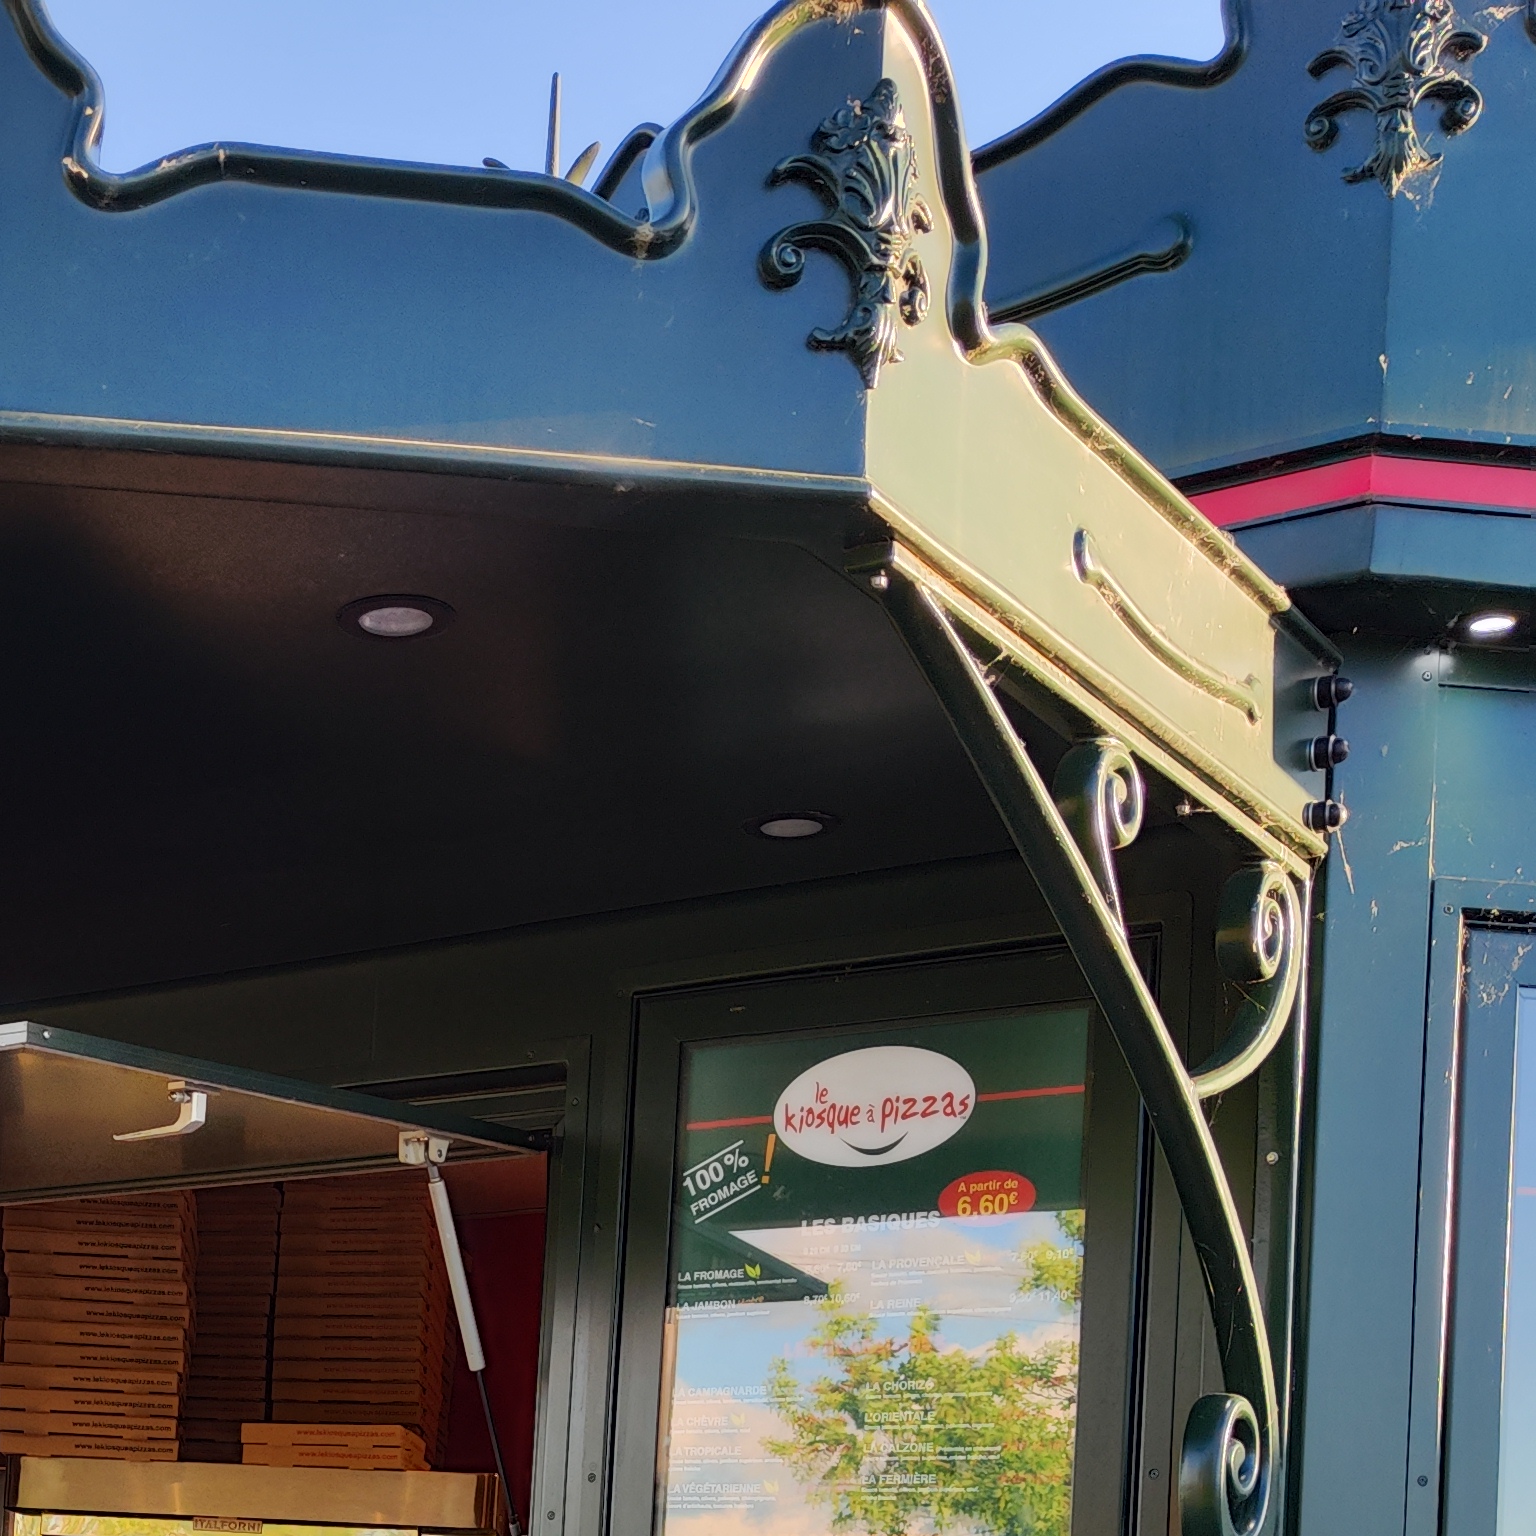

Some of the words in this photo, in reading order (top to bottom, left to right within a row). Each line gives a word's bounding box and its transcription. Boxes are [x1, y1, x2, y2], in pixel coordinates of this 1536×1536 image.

[815, 1081, 828, 1105] le
[784, 1102, 860, 1134] kiosque
[866, 1104, 875, 1123] à
[881, 1091, 970, 1133] pizzas
[690, 1170, 758, 1216] FROMAGE
[958, 1182, 966, 1192] A
[970, 1180, 1001, 1194] partir
[1004, 1178, 1018, 1188] de
[957, 1192, 1018, 1218] 6,60€
[801, 1219, 834, 1236] LES
[841, 1210, 940, 1234] BASIQUES
[678, 1273, 692, 1282] LA
[694, 1269, 744, 1280] FROMAGE
[195, 1519, 260, 1532] ITALFORNI
